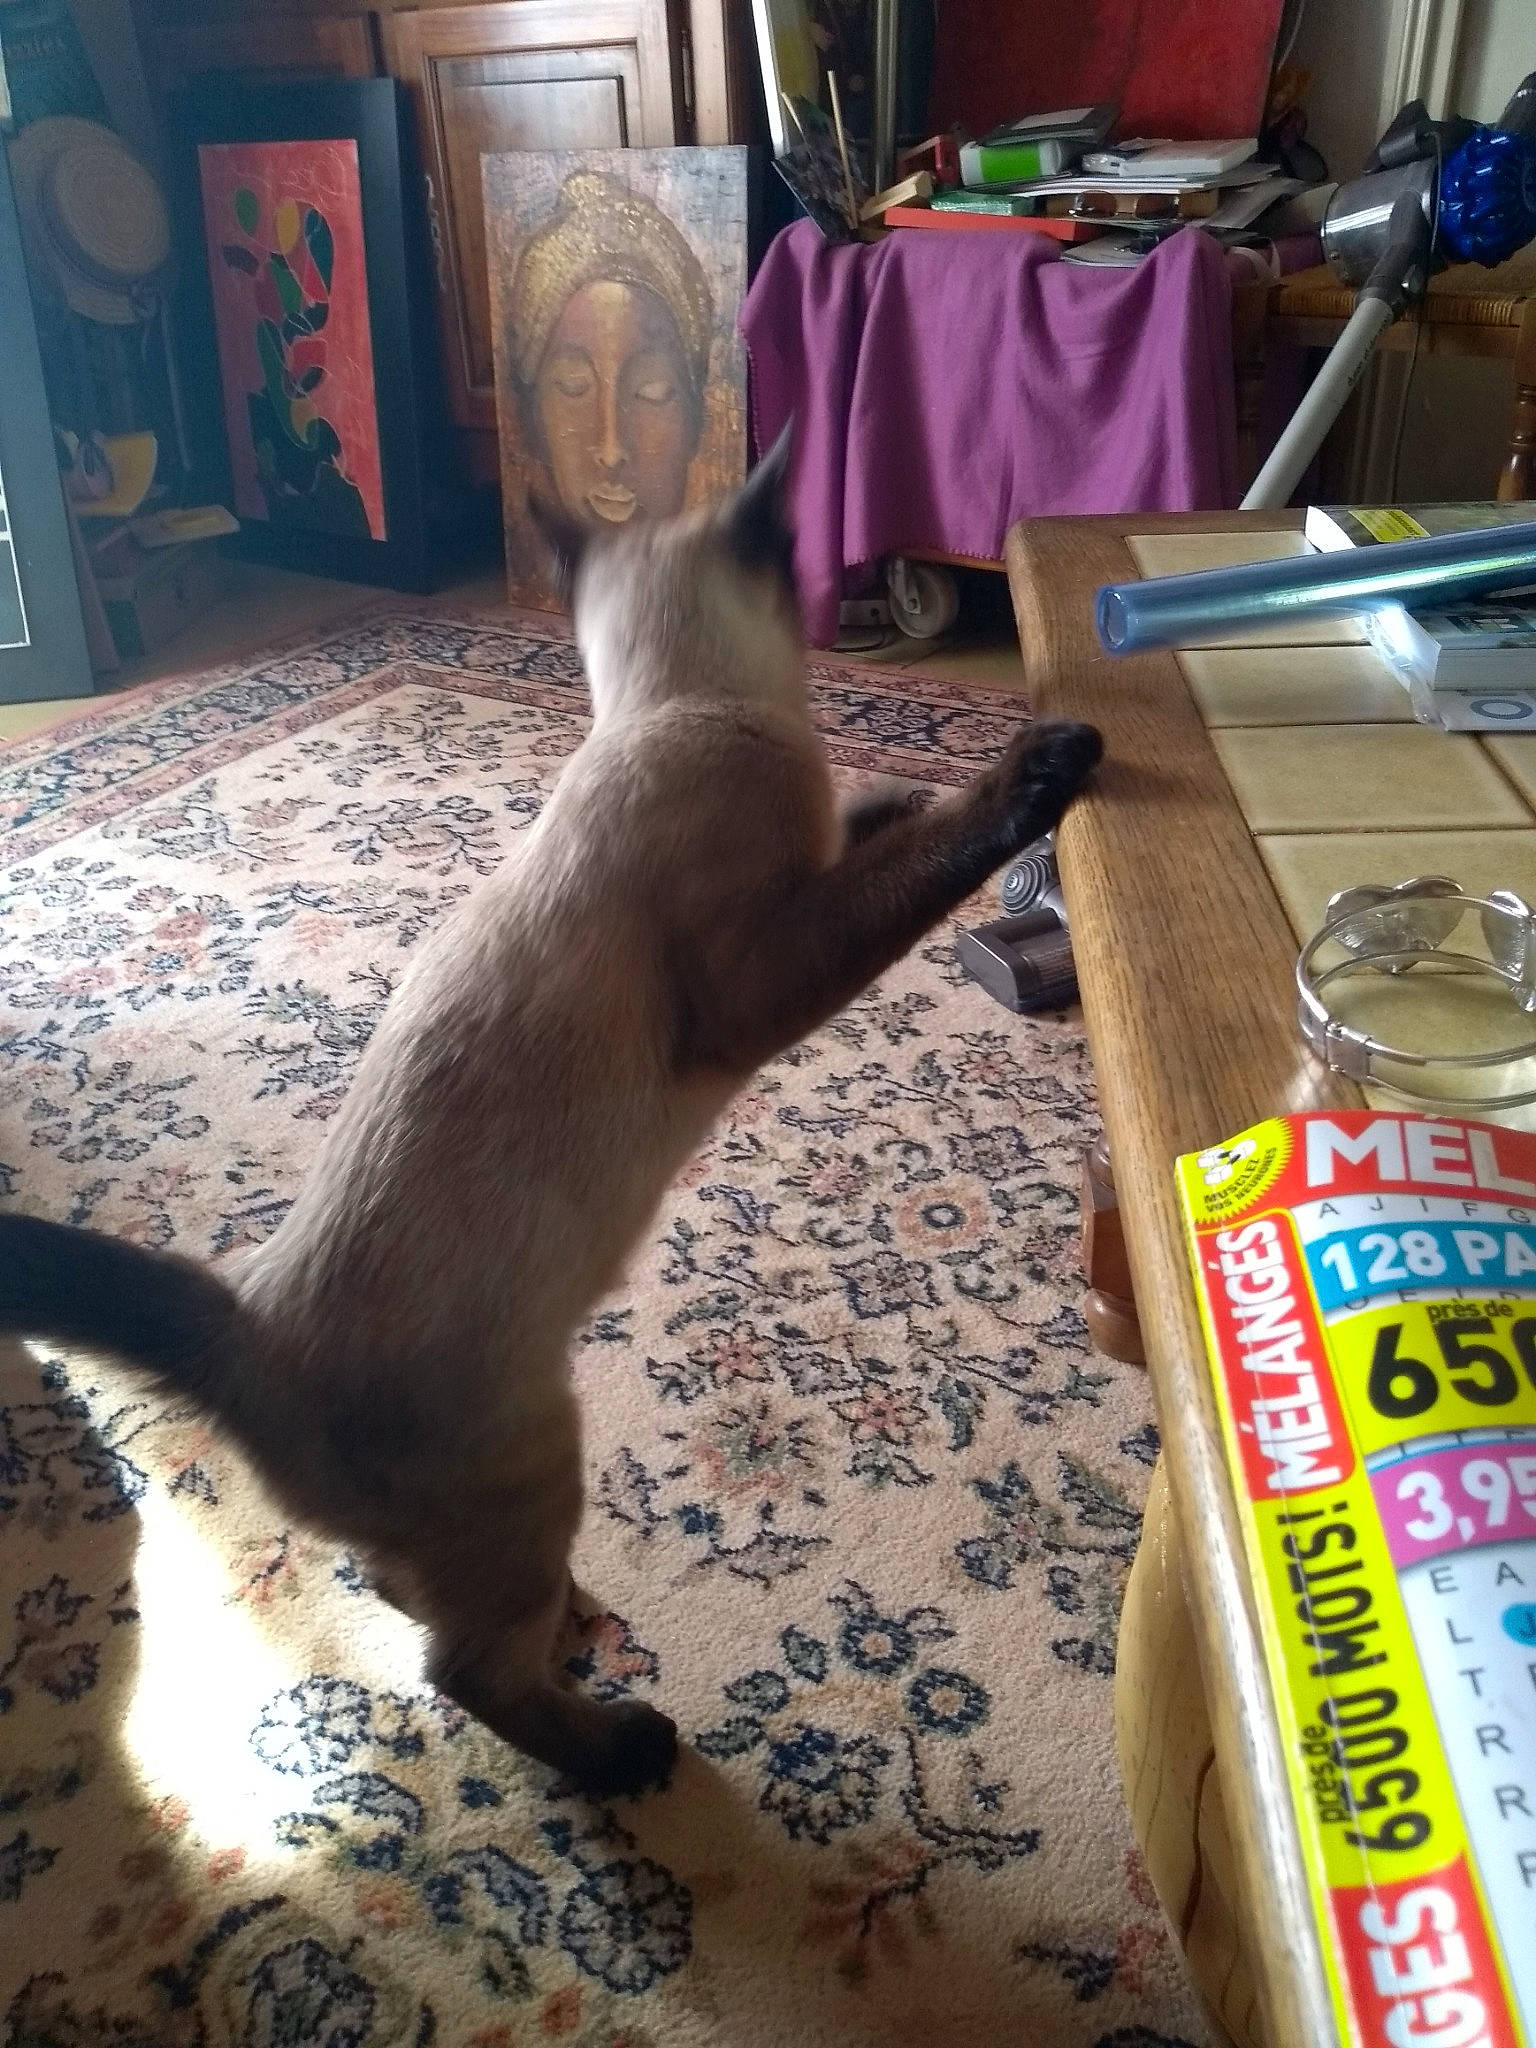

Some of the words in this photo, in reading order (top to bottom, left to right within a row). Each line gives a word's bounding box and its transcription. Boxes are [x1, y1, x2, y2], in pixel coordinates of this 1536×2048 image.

[1319, 1202, 1340, 1219] A
[1321, 1230, 1447, 1291] 128
[1207, 1220, 1342, 1490] MÉLANGÉS
[1484, 1299, 1516, 1318] de
[1277, 1500, 1388, 1677] MOTS!
[1430, 1566, 1458, 1594] E
[1495, 1561, 1524, 1587] A
[1318, 1687, 1433, 1852] 6500
[1360, 1887, 1491, 2048] GES
